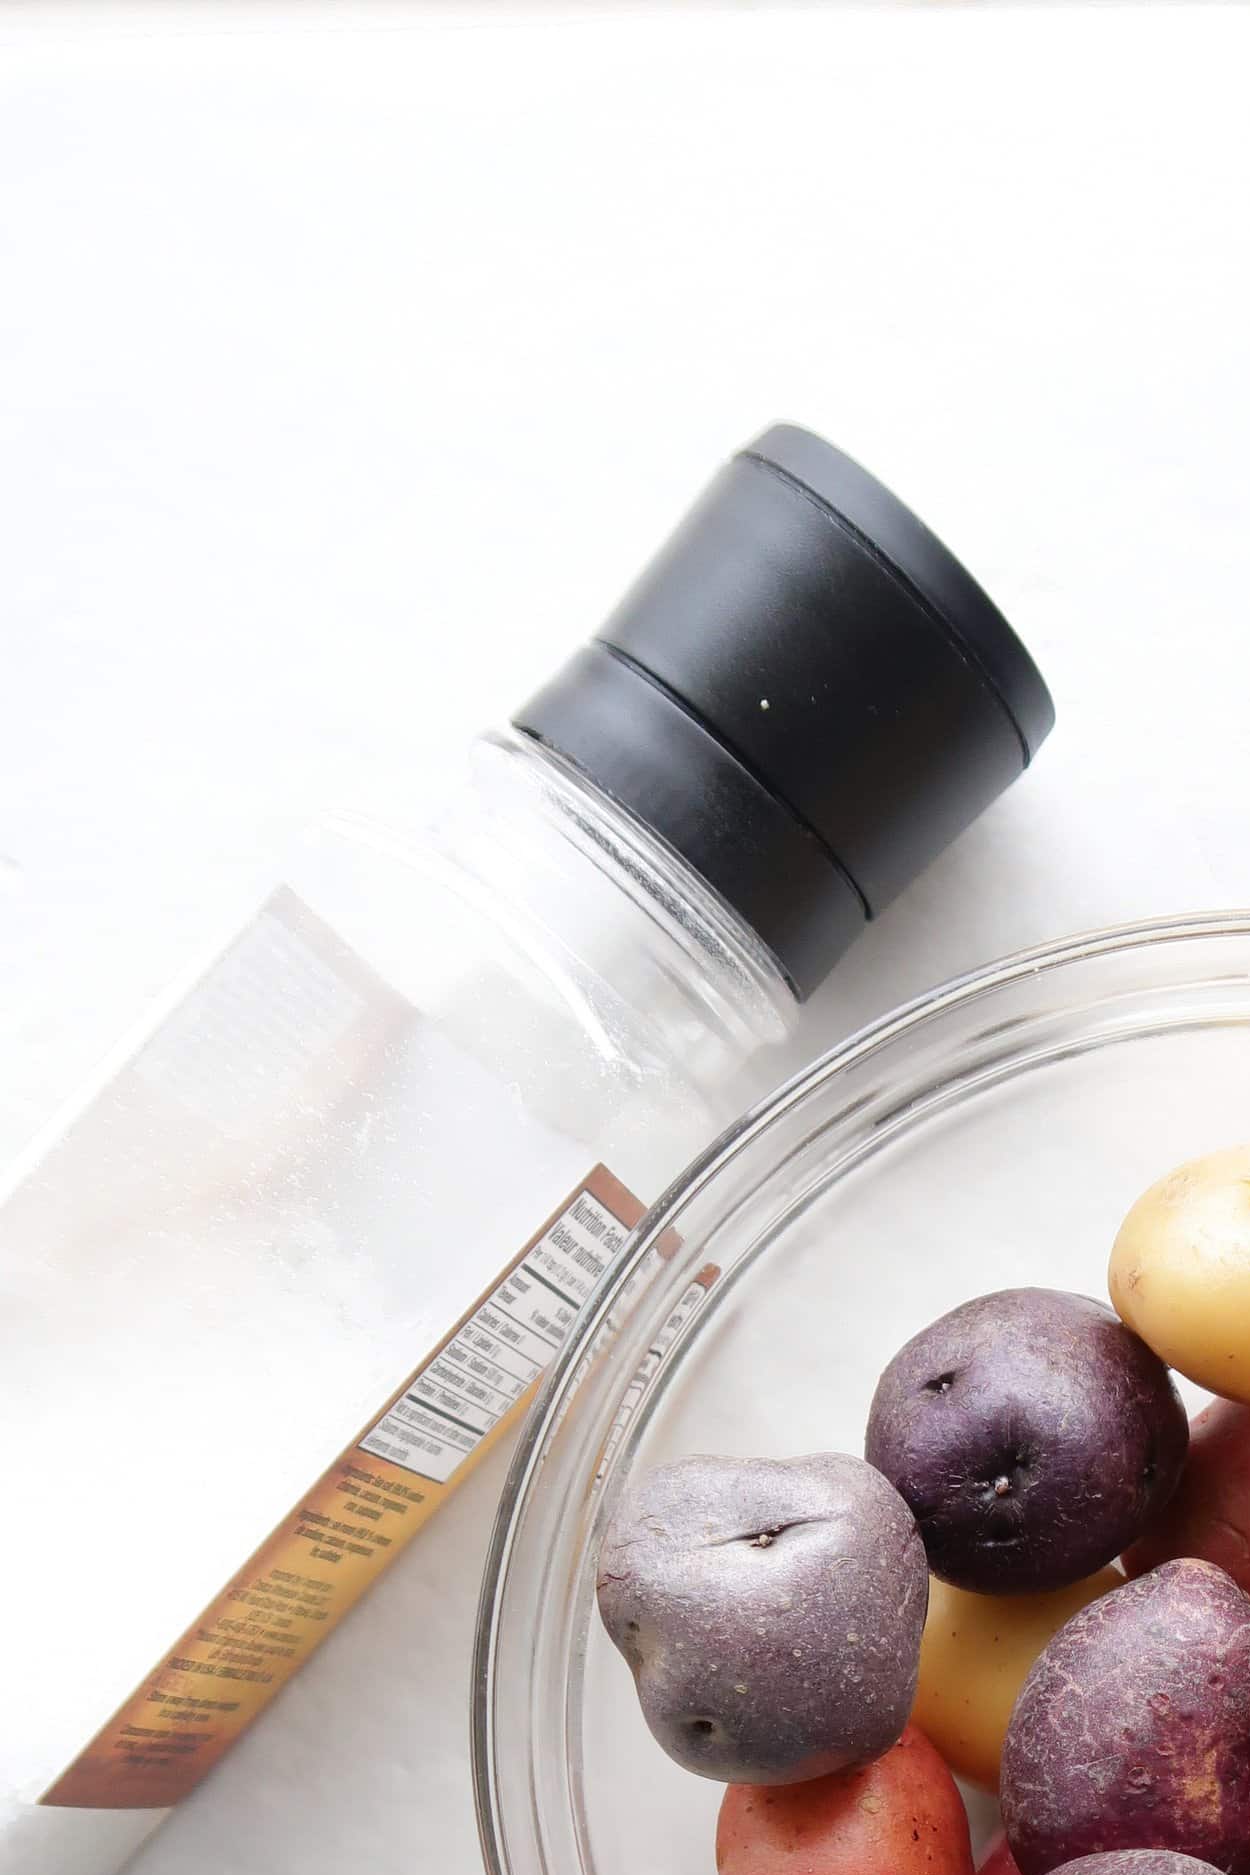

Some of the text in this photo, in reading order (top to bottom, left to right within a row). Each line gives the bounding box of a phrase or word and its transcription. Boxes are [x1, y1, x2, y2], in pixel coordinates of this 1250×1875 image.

[546, 1221, 581, 1255] Valeur
[571, 1243, 606, 1278] nutritive
[568, 1197, 625, 1253] Nutrition Facts
